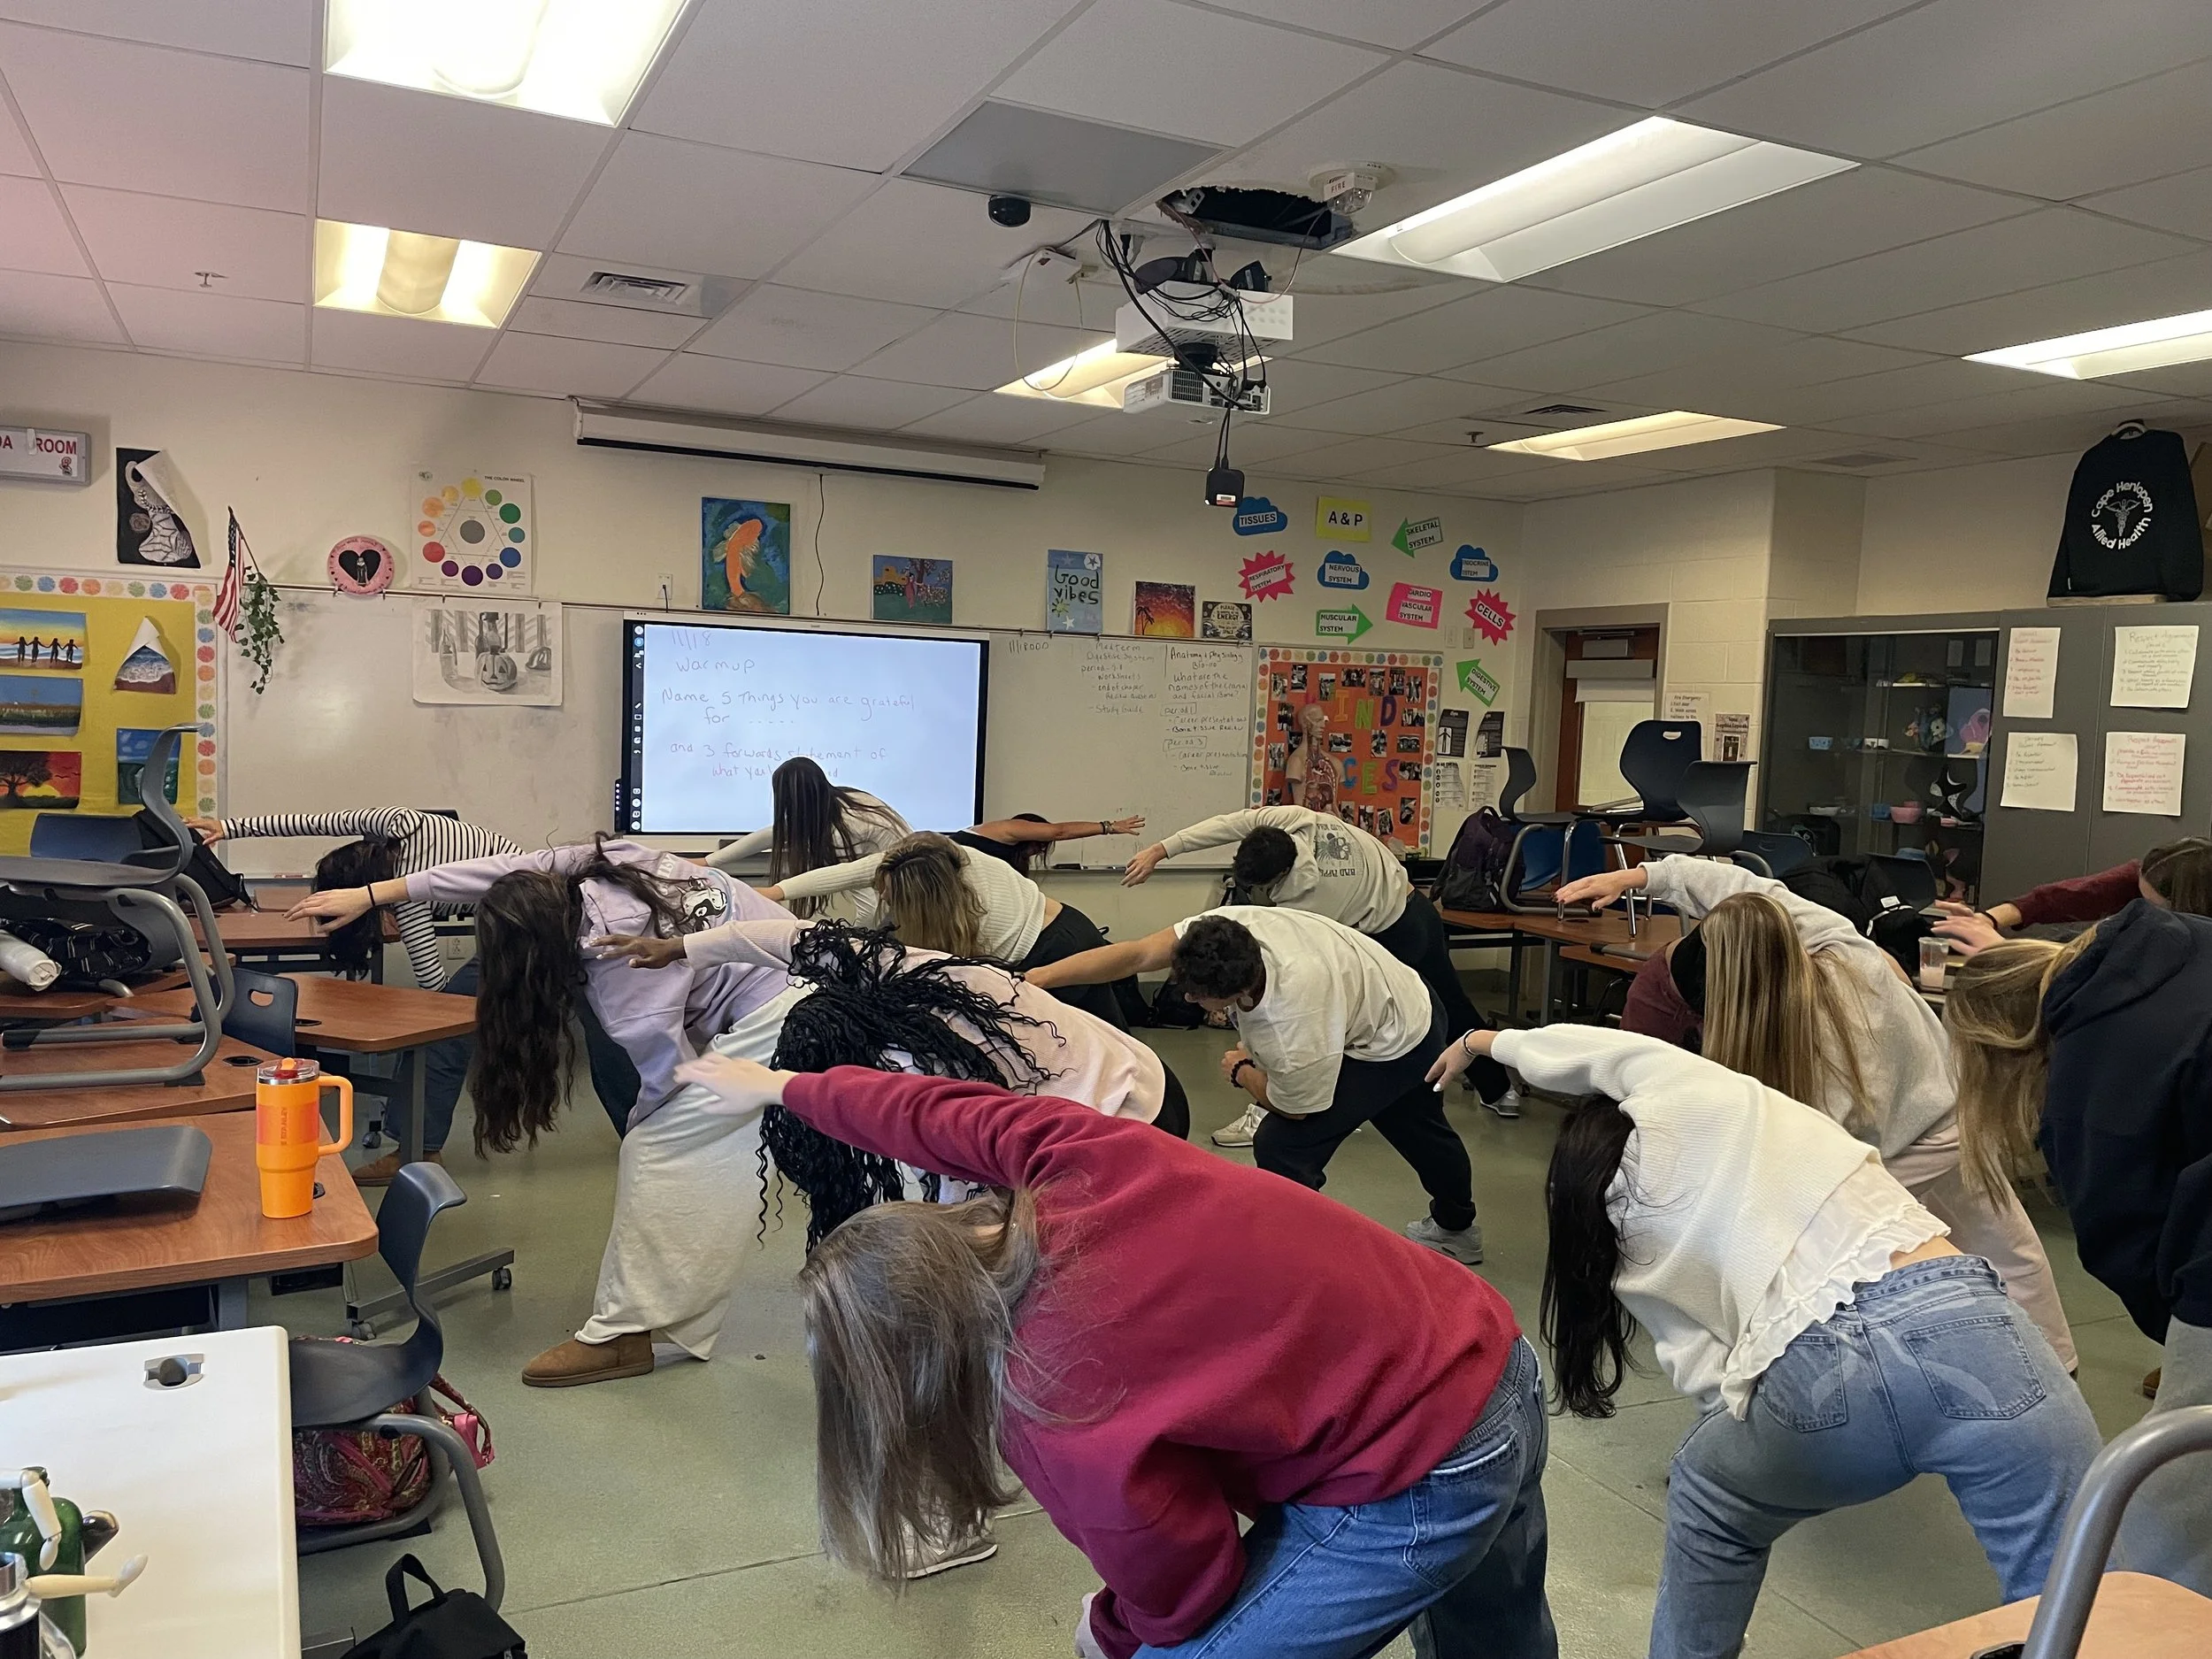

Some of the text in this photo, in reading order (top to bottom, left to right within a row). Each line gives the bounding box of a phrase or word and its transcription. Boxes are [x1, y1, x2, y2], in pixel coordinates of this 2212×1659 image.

[1331, 180, 1346, 193] FIRE
[0, 434, 77, 455] A ROOM
[2091, 481, 2154, 518] Cape Henlopen
[1240, 512, 1277, 526] TISSUES
[1328, 511, 1363, 526] A & P
[1406, 520, 1440, 536] SKELETAL
[2091, 518, 2152, 549] Allied Health
[1408, 535, 1435, 549] SYSTEM
[1248, 565, 1285, 581] RESPIRATORY
[1329, 564, 1360, 573] NERVOUS
[1055, 565, 1100, 590] Good
[1251, 580, 1272, 591] SYSTEM
[1328, 575, 1352, 584] SYSTEM
[1409, 588, 1432, 598] CARDIO
[1402, 602, 1432, 611] VASCULAR
[1399, 611, 1424, 621] SYSTEM
[1477, 603, 1504, 627] CELLS
[1467, 677, 1486, 695] SYSTEM
[1471, 668, 1497, 692] DIGESTIVE
[662, 687, 710, 704] Name
[828, 694, 855, 705] are
[860, 694, 915, 721] grateful
[704, 707, 730, 725] for
[670, 742, 693, 754] and
[703, 744, 716, 758] 3
[787, 745, 863, 760] sttement
[870, 747, 888, 760] of
